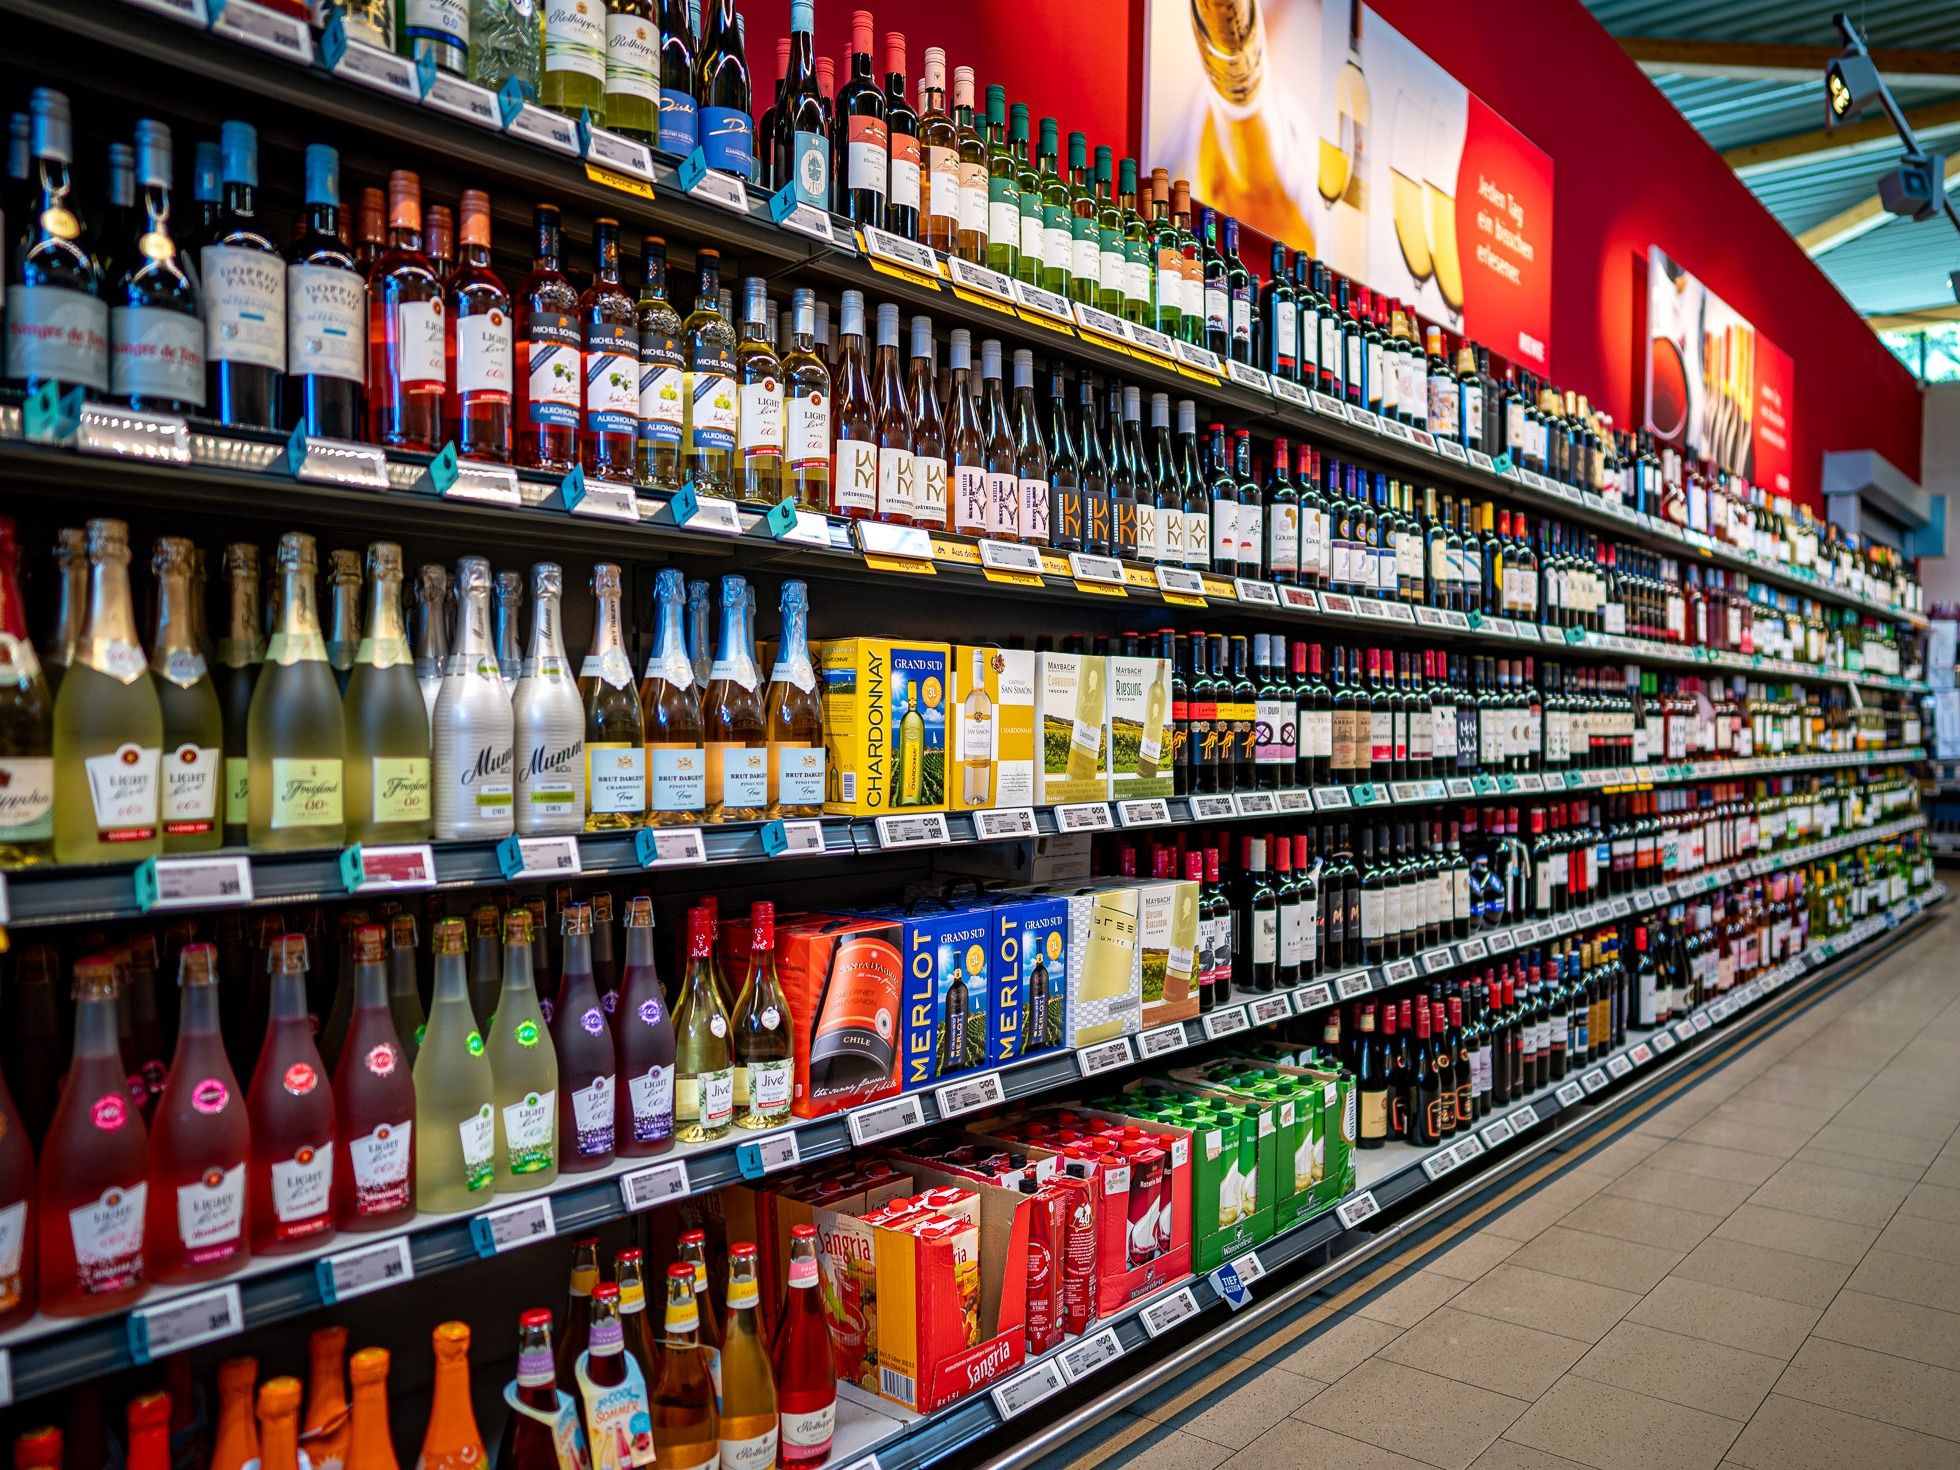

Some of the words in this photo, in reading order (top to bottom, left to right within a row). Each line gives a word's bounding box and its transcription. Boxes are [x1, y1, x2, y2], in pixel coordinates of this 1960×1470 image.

[758, 397, 780, 409] LIGHT
[804, 411, 826, 422] LIGHT
[894, 658, 926, 670] GRAND
[927, 660, 943, 671] SUD
[1047, 661, 1076, 671] MAYBACH
[1115, 666, 1142, 675] MAYBACH
[927, 686, 937, 698] 3L
[1001, 686, 1014, 694] SAN
[1014, 686, 1033, 695] SIMÓN
[866, 650, 885, 808] CHARDONNAY
[1145, 896, 1171, 905] MAYBACH
[1025, 918, 1050, 930] GRAND
[1050, 915, 1063, 926] SUD
[941, 931, 970, 944] GRAND
[970, 928, 985, 938] SUD
[1050, 941, 1058, 951] 3L
[971, 955, 980, 966] 3L
[998, 915, 1019, 1060] MERLOT
[910, 928, 934, 1083] MERLOT
[843, 1035, 871, 1047] CHILE
[644, 1079, 667, 1090] LIGHT
[761, 1072, 785, 1087] Jive
[712, 1081, 731, 1098] Jive
[813, 1085, 827, 1098] the
[864, 1086, 878, 1102] of
[878, 1078, 898, 1091] chile
[588, 1090, 610, 1102] LIGHT
[519, 1106, 546, 1118] LIGHT
[1078, 1213, 1090, 1224] 40
[816, 1223, 872, 1263] Sangria
[1221, 1275, 1238, 1286] TIEF
[966, 1340, 1011, 1390] Sangria
